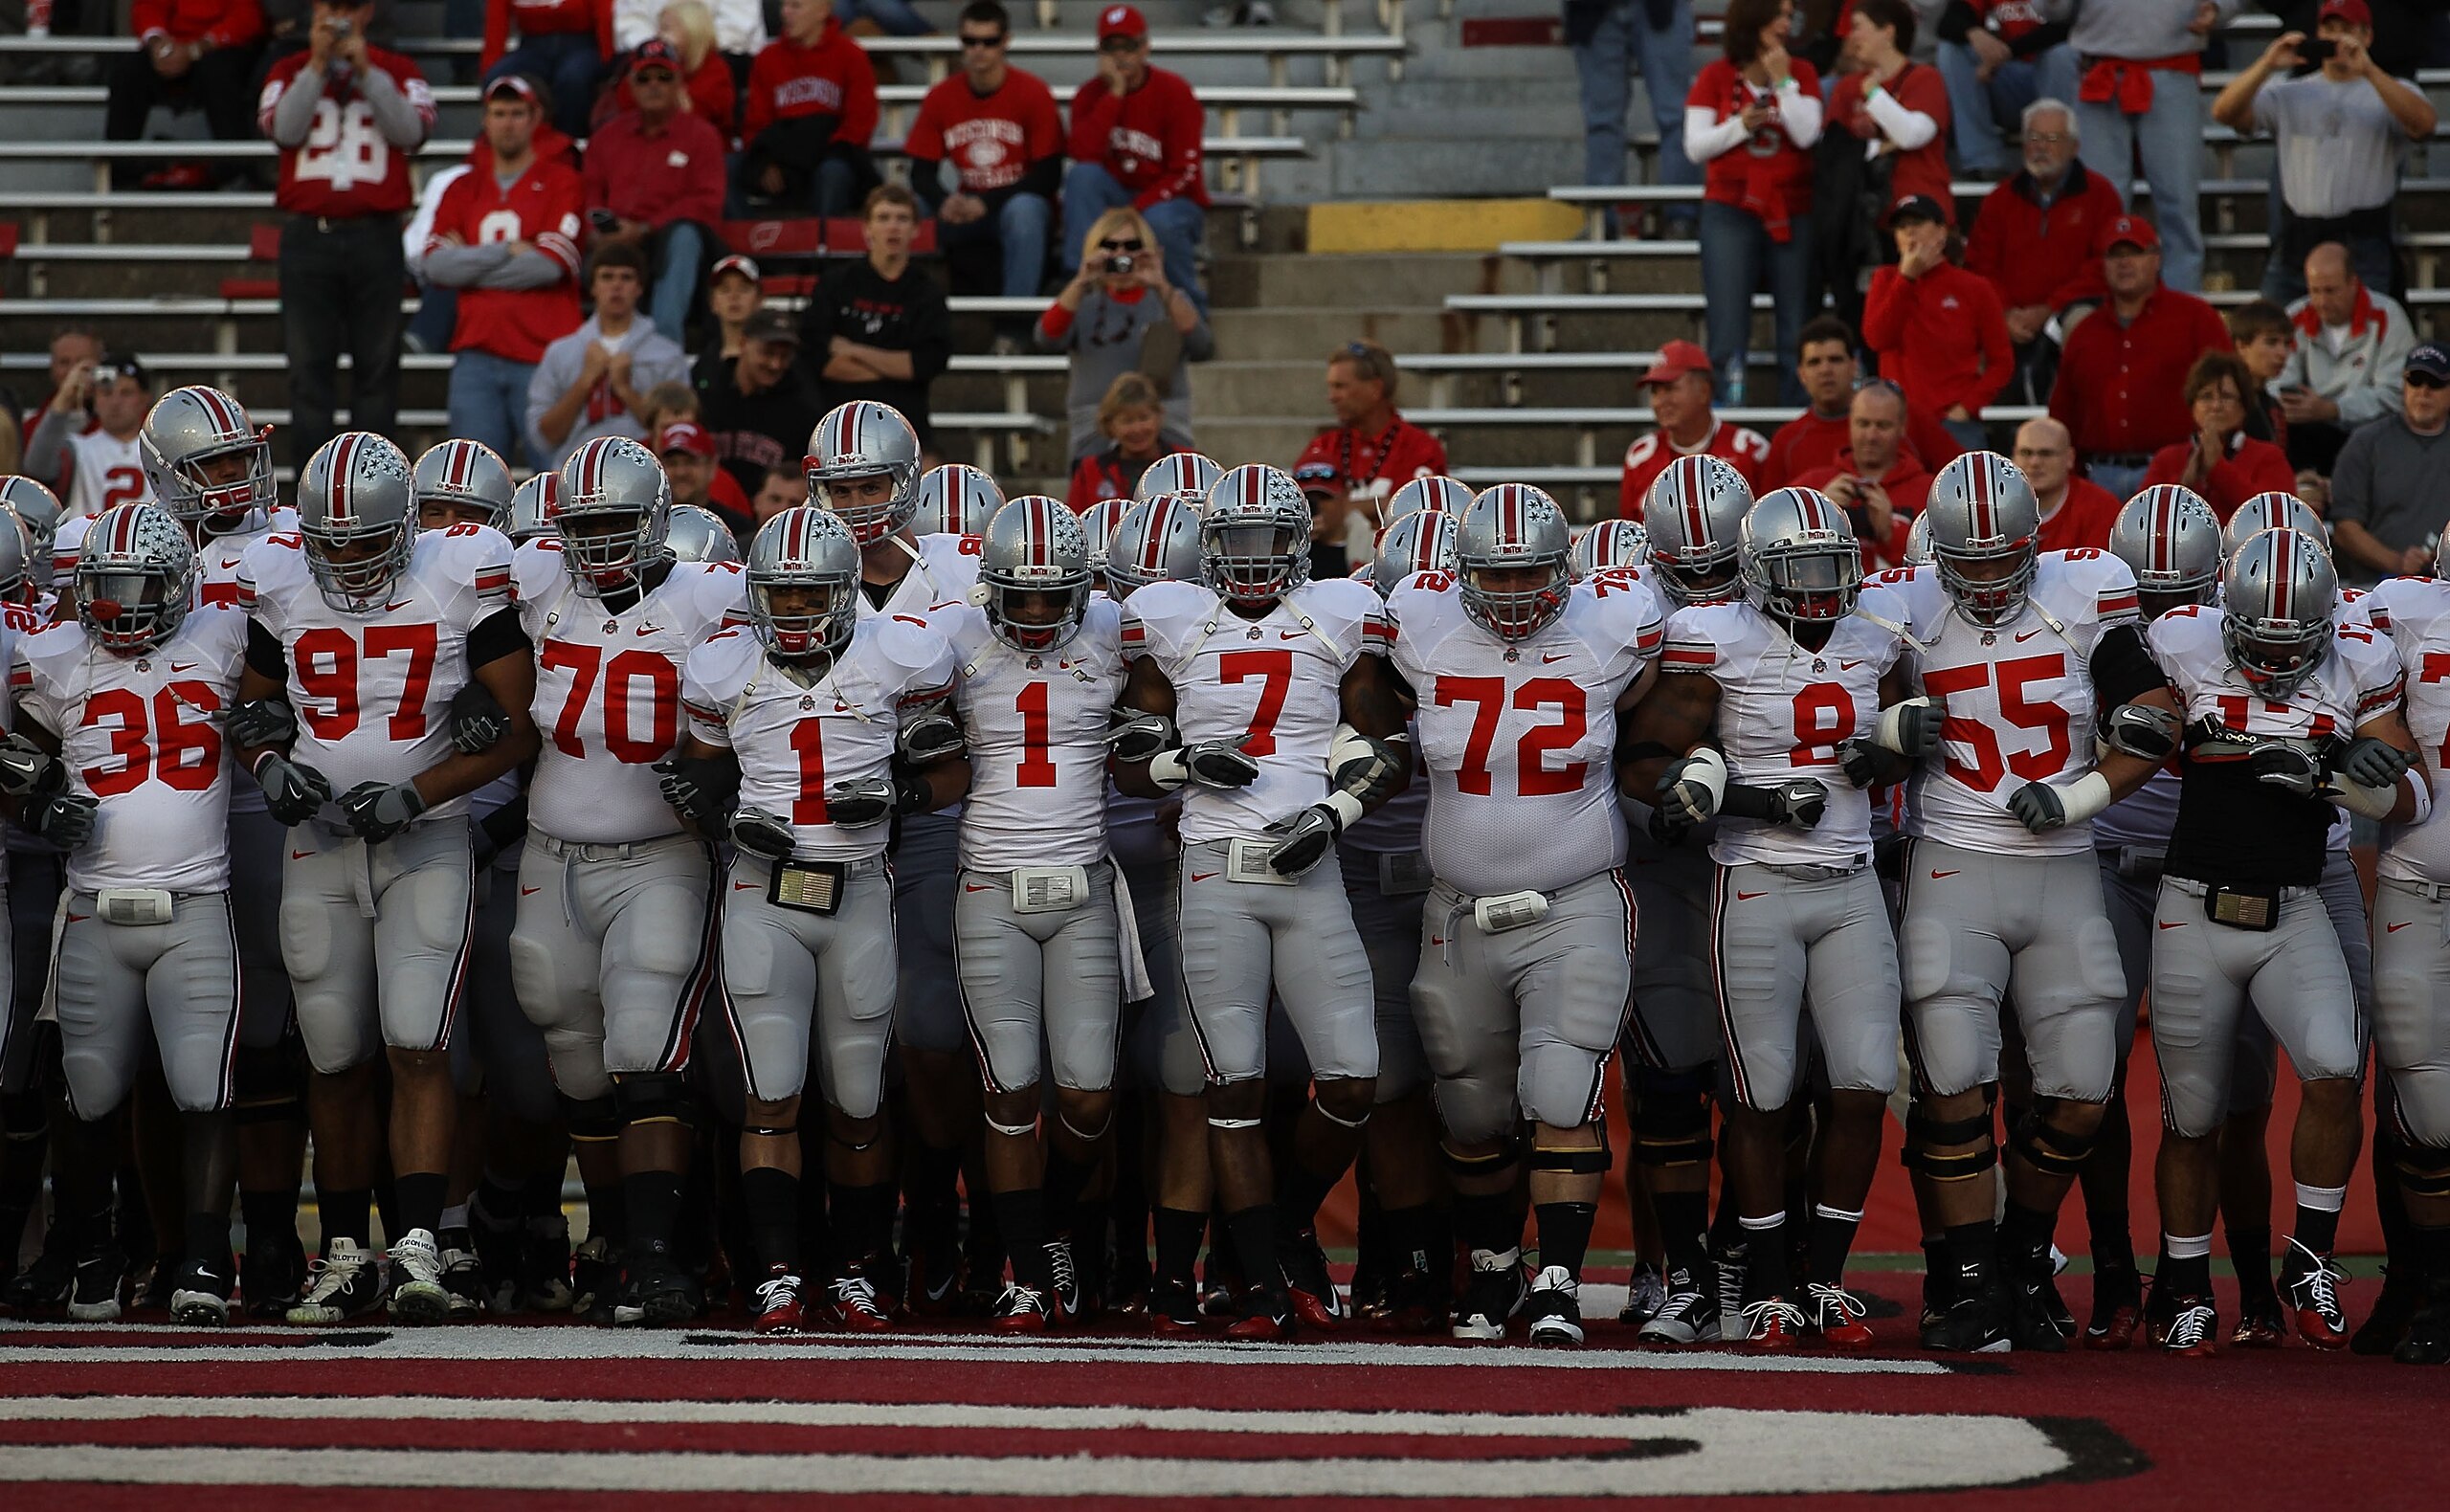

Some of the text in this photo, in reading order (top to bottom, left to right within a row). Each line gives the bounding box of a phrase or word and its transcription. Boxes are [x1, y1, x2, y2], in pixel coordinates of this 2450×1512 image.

[80, 680, 222, 797] 36
[294, 623, 437, 742] 97
[541, 638, 679, 765] 70
[1015, 681, 1058, 789] 1
[1219, 650, 1293, 758] 7
[1434, 676, 1590, 797] 72
[1790, 681, 1856, 768] 8
[1922, 653, 2072, 794] 55
[790, 717, 835, 826] 1
